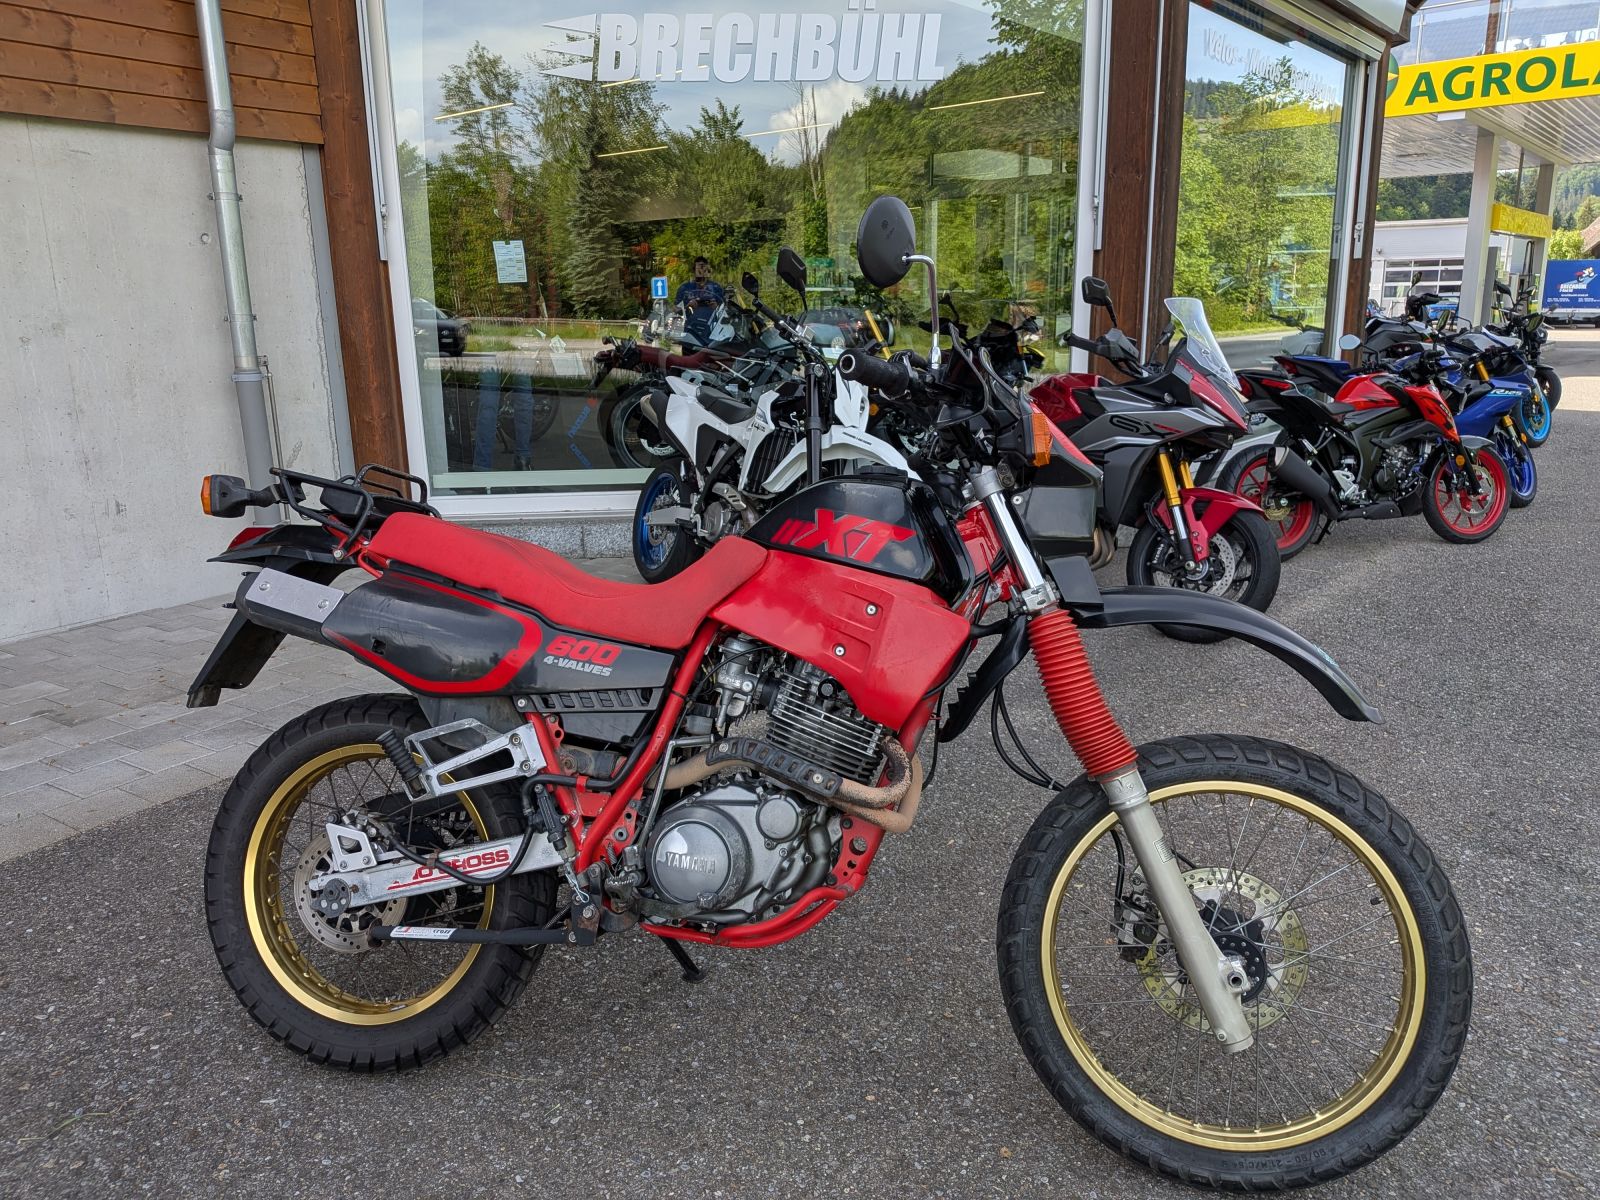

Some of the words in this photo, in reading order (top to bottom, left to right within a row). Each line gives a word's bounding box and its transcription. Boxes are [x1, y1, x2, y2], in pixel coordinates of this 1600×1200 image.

[597, 0, 945, 83] BRECHBÜHL
[545, 635, 622, 666] 600
[543, 655, 613, 677] 4-VALVES
[667, 852, 716, 874] YAMAHA
